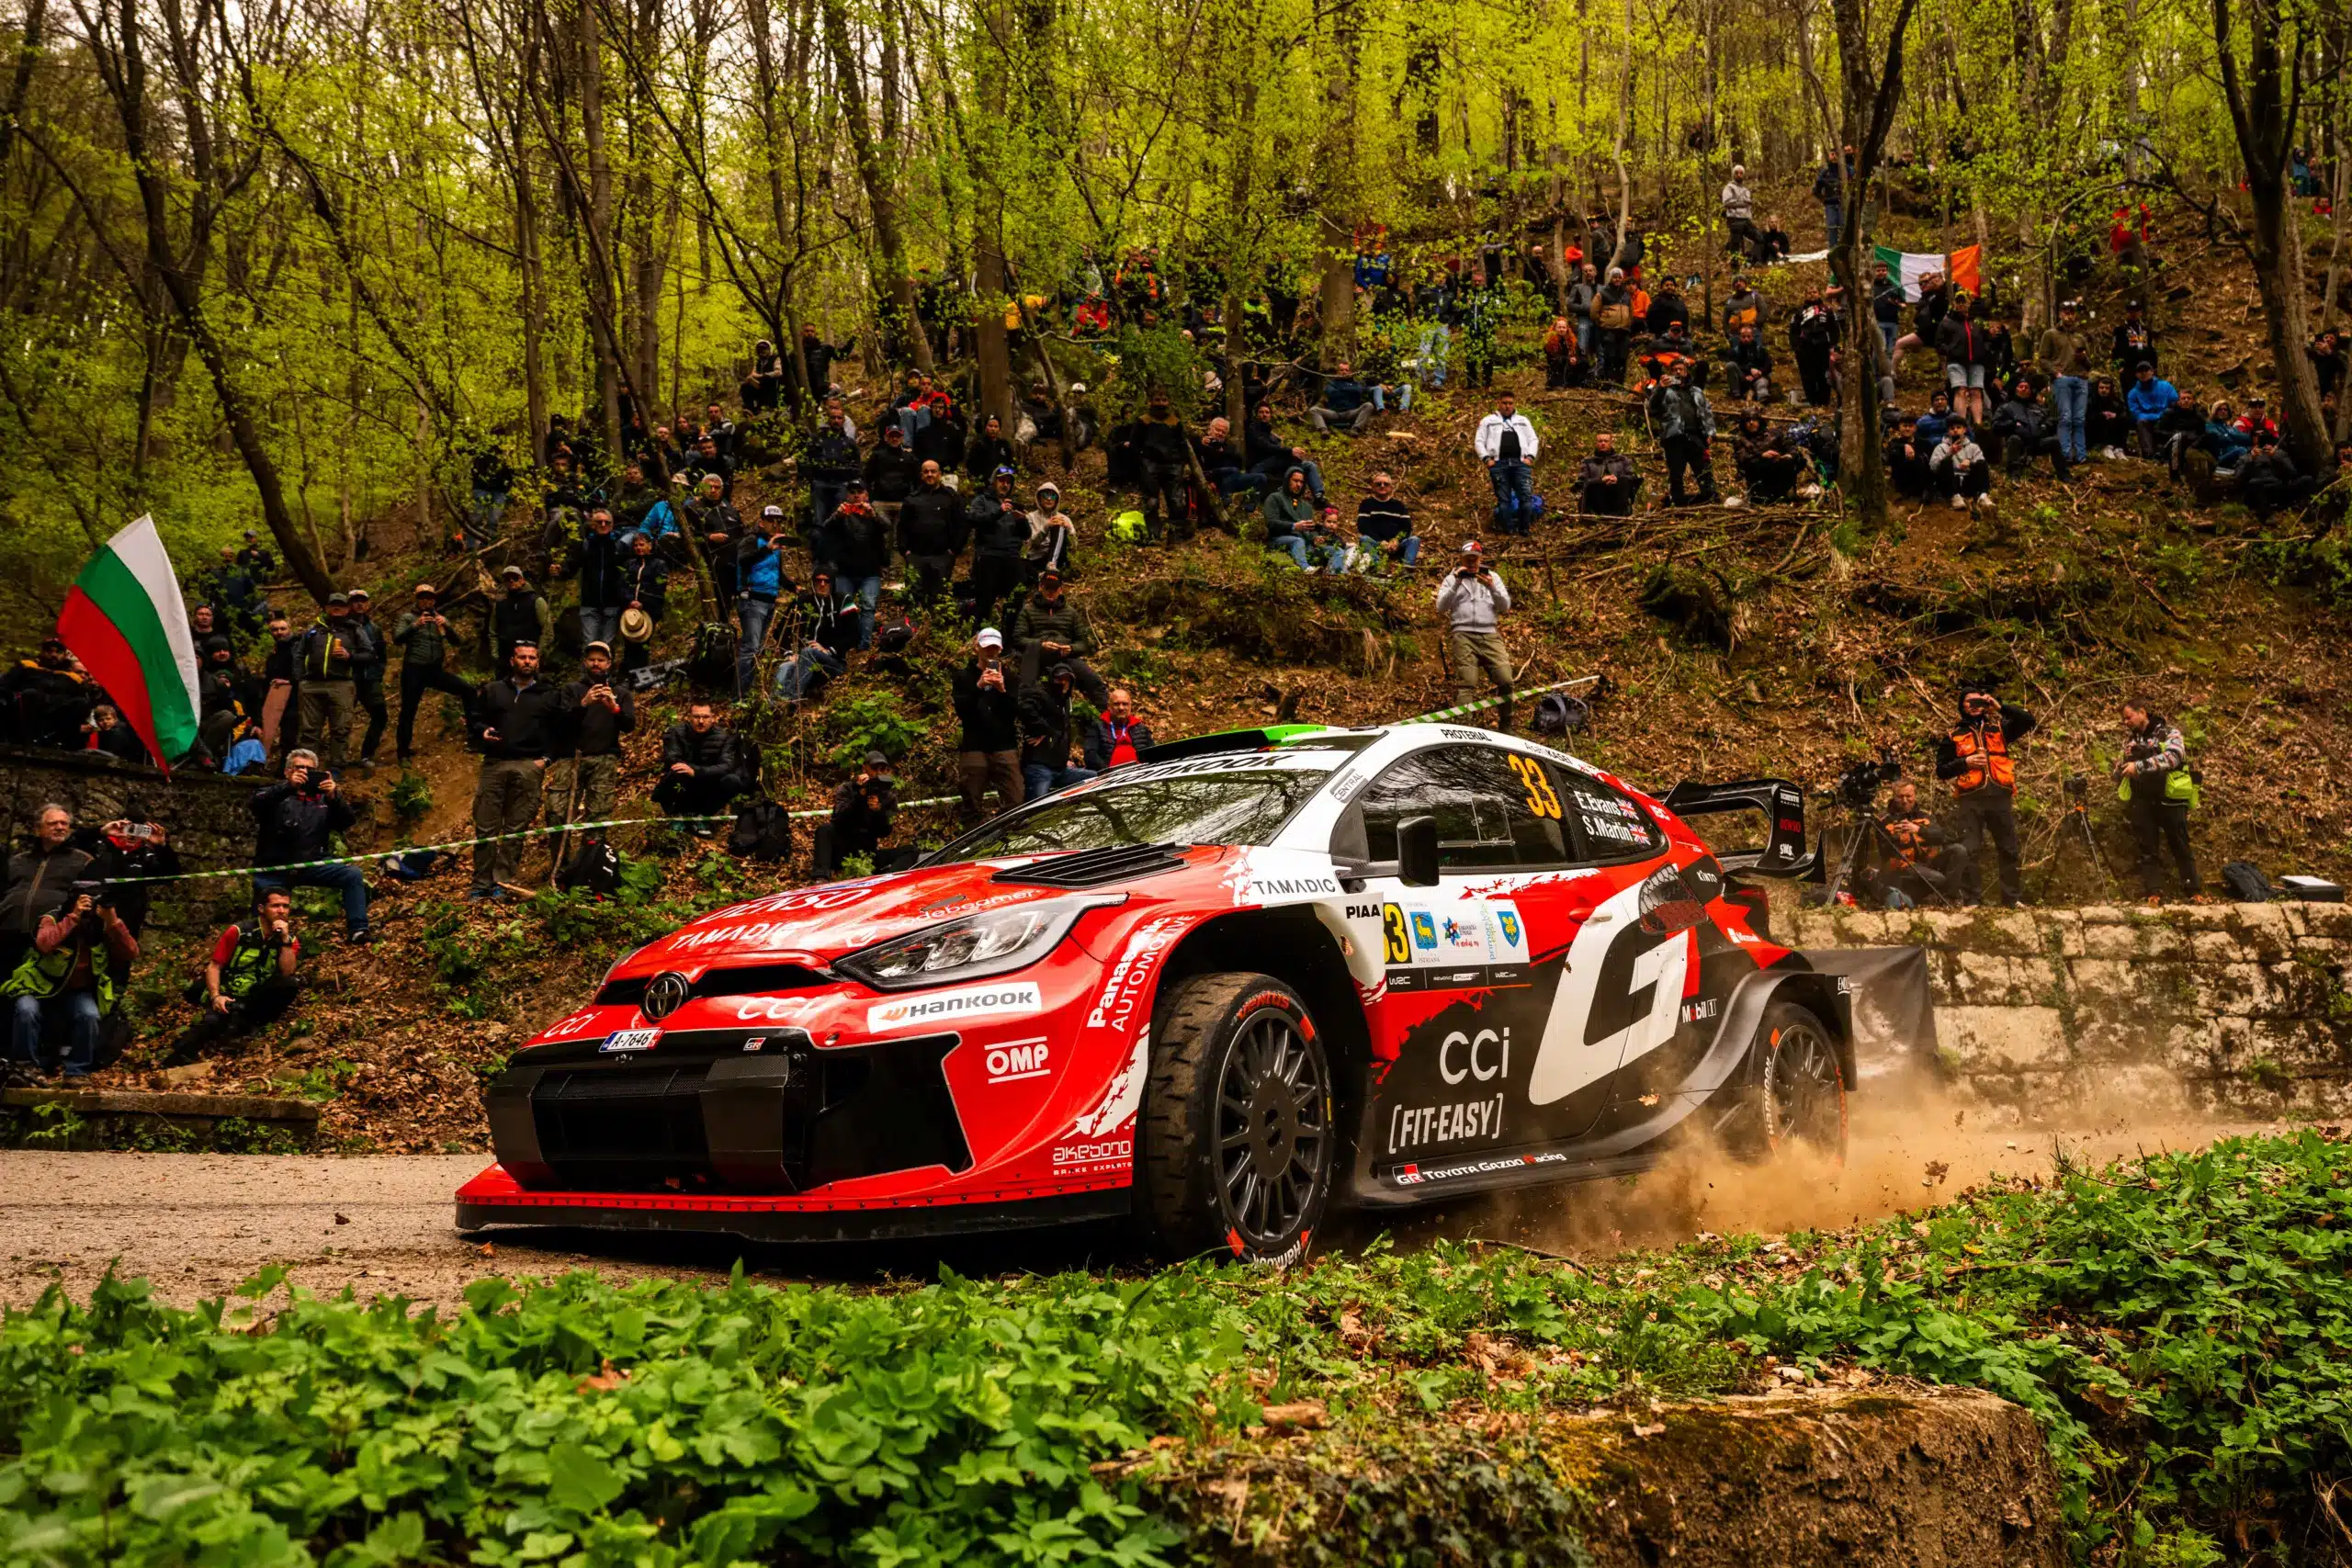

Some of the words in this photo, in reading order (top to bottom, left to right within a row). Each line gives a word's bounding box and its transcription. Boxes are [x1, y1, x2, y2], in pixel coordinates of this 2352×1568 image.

[1440, 728, 1493, 742] PROTERIAL
[1333, 773, 1363, 801] CENTRAL
[1507, 753, 1562, 819] 33
[1573, 790, 1621, 817] E.Evans
[1581, 814, 1633, 842] S.Martin
[1252, 878, 1336, 895] TAMADIC
[693, 888, 873, 927] DENSO
[1345, 904, 1380, 919] PIAA
[1384, 903, 1409, 964] 3
[1111, 915, 1195, 1032] AUTOMOTIVE
[1388, 976, 1411, 986] WRC
[1681, 1000, 1707, 1023] Mobil
[986, 1043, 1049, 1076] OMP
[1439, 1026, 1510, 1085] CCi
[1053, 1141, 1132, 1162] akebono
[1394, 1168, 1425, 1185] GR
